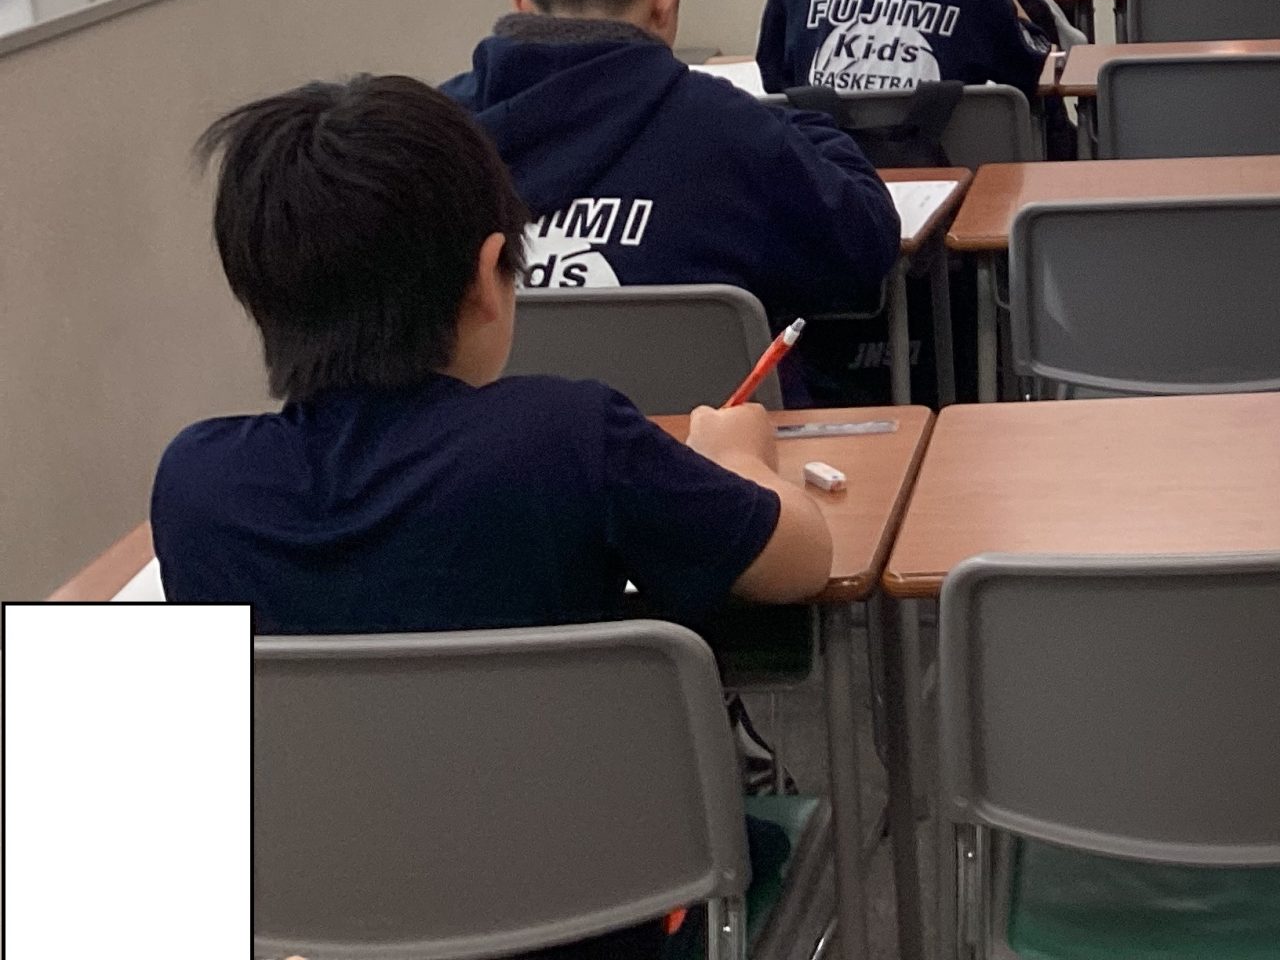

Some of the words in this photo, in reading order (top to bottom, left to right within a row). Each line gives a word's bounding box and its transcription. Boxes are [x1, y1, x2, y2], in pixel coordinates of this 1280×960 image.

[834, 33, 919, 63] Kids
[813, 71, 922, 89] BASKETBA
[524, 253, 589, 288] ds
